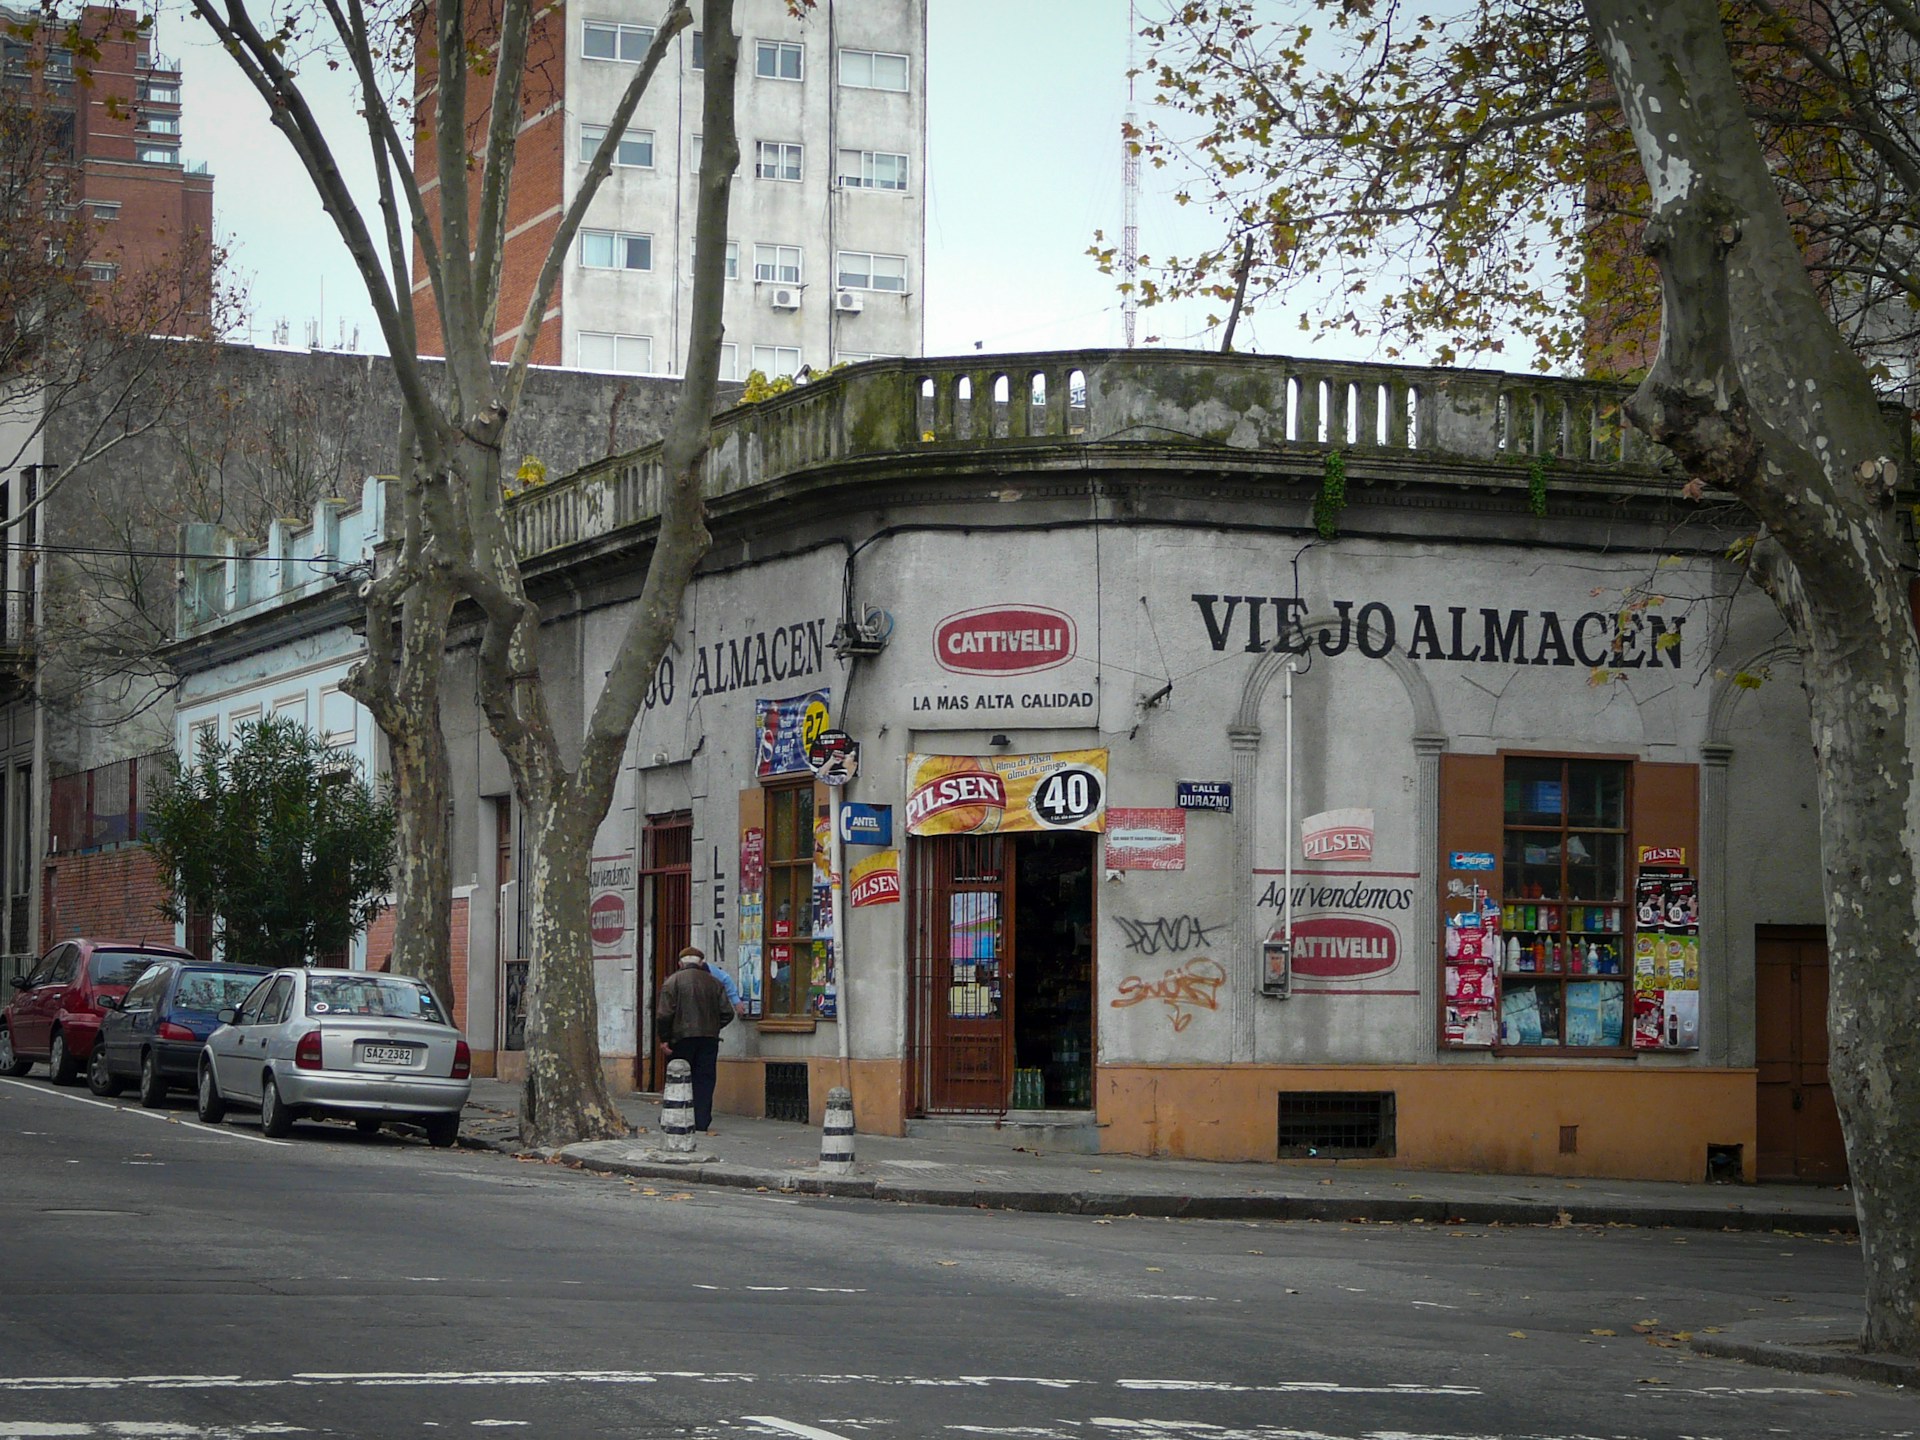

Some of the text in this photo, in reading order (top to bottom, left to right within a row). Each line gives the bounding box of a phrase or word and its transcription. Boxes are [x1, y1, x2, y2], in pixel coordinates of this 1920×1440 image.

[947, 629, 1062, 654] CATTIVELLI
[1191, 594, 1686, 669] VIEJO ALMACEN
[691, 618, 825, 698] ALMACEN
[913, 692, 1093, 711] LA MAS ALTA CALIDAD
[805, 711, 824, 745] 27
[996, 753, 1051, 772] Alma de Pilsen
[1007, 760, 1068, 780] alma de amigos
[1043, 774, 1089, 814] 40
[1179, 794, 1230, 807] DURAZNO
[1192, 785, 1220, 793] CALLE
[905, 776, 1000, 828] PILSEN
[852, 816, 878, 827] ANTEL
[1304, 834, 1371, 858] PILSEN
[1643, 848, 1681, 862] PILSEN
[851, 876, 899, 906] PILSEN
[1256, 880, 1414, 916] Aquí vendemos
[714, 845, 725, 971] LEÑ
[1292, 936, 1389, 959] ATTIVELLI
[387, 1048, 410, 1060] 2382
